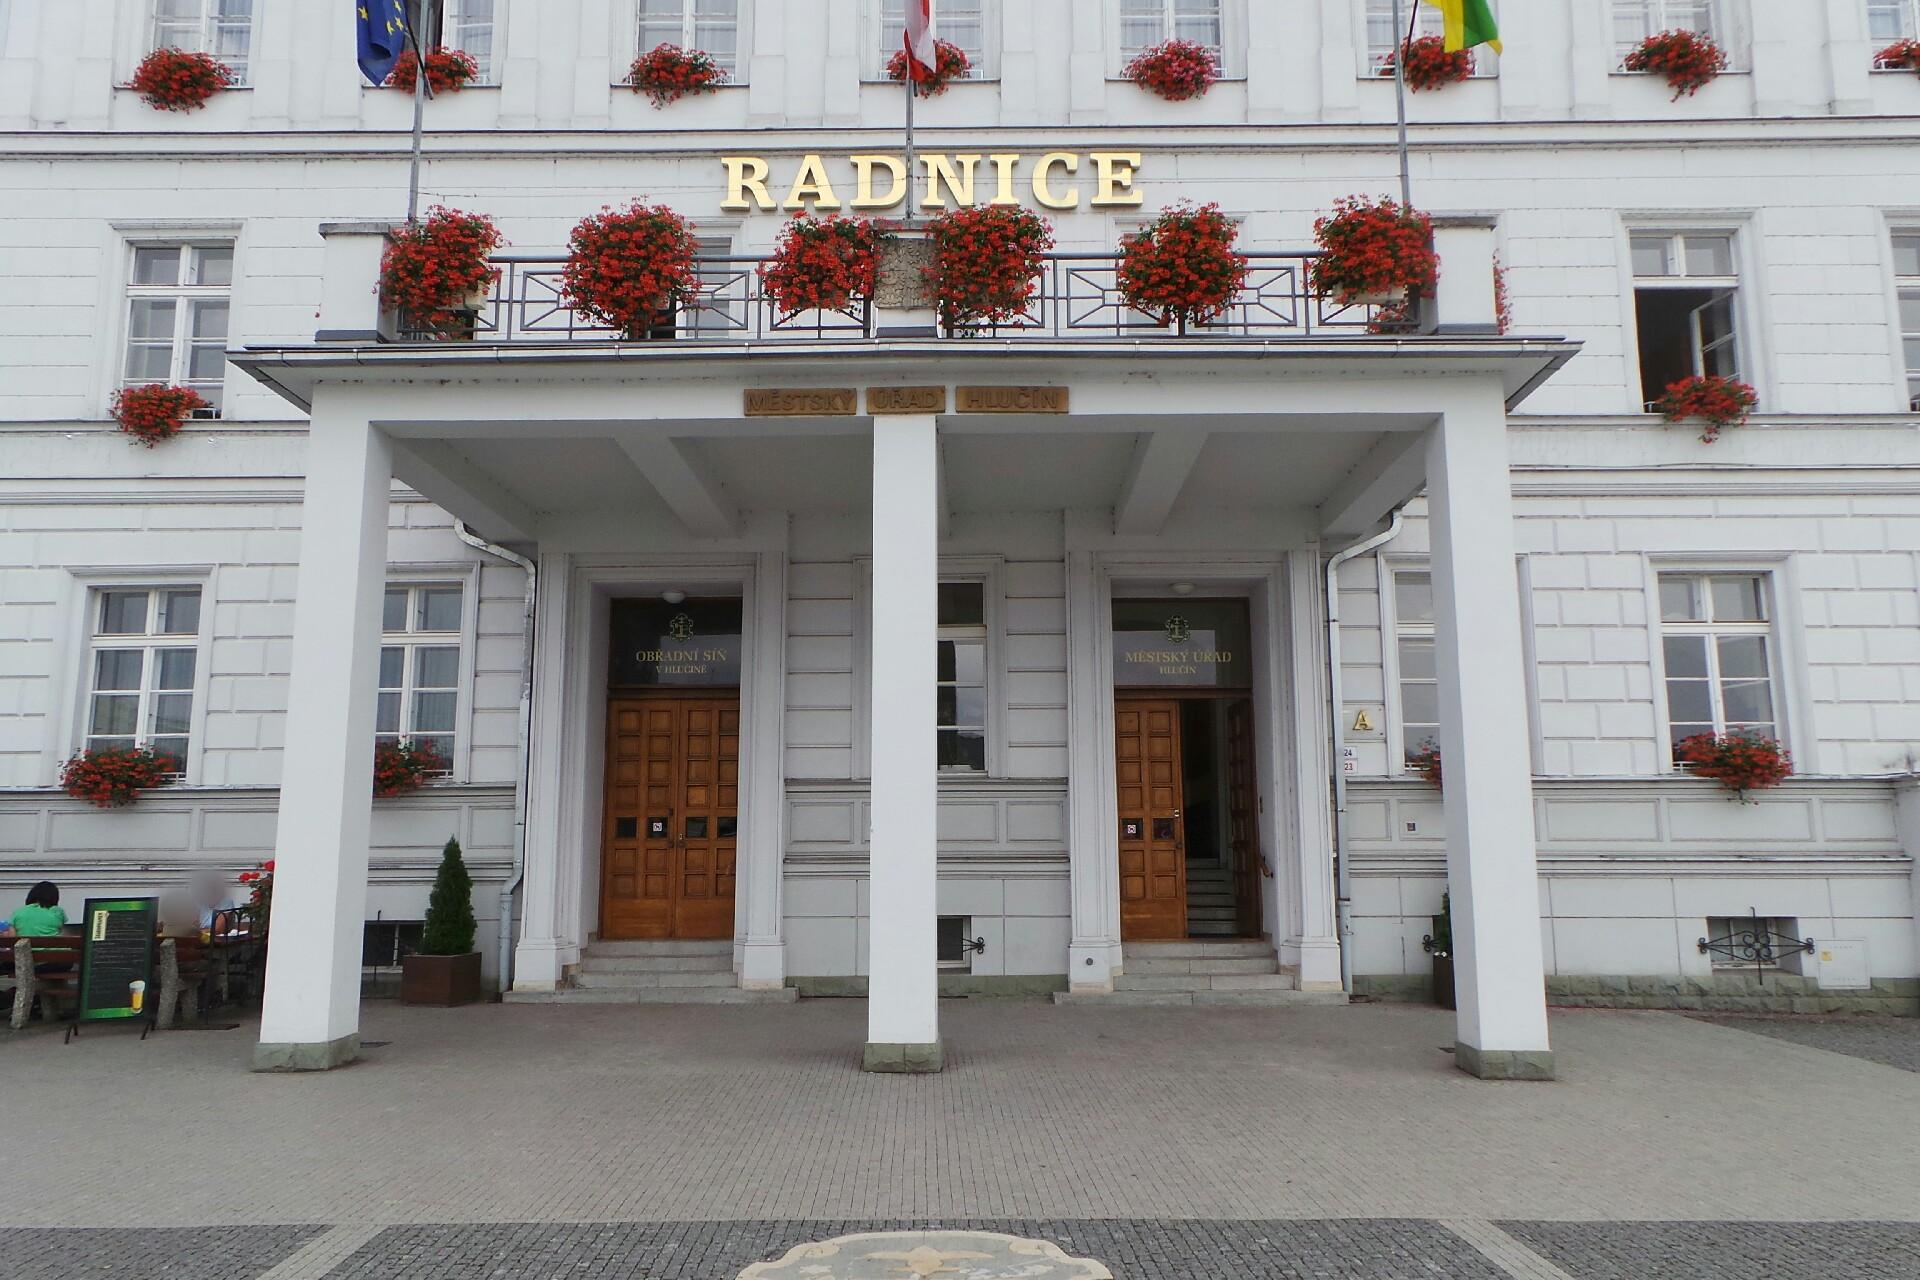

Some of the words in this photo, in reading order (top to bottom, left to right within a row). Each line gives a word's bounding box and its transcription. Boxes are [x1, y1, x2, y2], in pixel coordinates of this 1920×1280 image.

[719, 152, 1144, 210] RADNICE
[636, 648, 698, 662] OBŘADNÍ
[1125, 649, 1189, 662] MĚSTSKÝ
[656, 665, 663, 673] V
[1352, 710, 1373, 730] A
[1343, 749, 1353, 757] 24
[1344, 762, 1353, 771] 23
